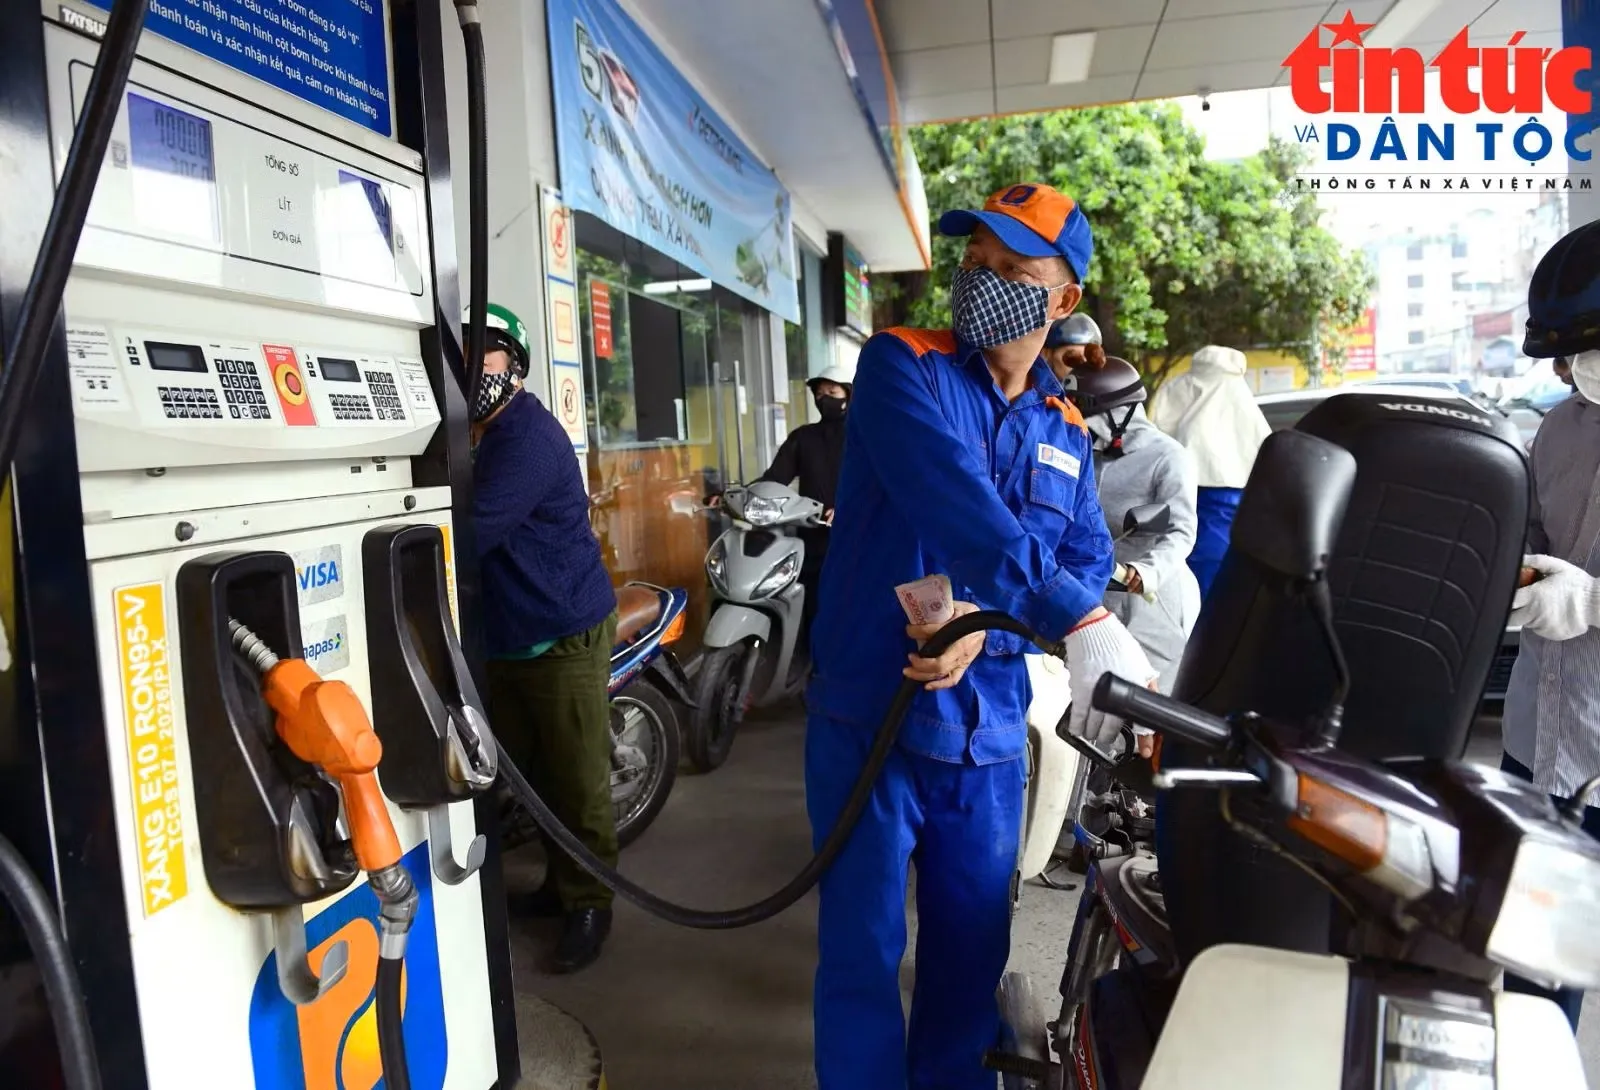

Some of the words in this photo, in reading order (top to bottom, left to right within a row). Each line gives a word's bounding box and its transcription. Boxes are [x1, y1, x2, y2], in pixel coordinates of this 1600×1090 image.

[150, 0, 182, 25] thanh
[184, 16, 208, 37] toán
[210, 29, 223, 44] và
[226, 37, 243, 53] xác
[244, 46, 268, 66] nhận
[270, 54, 284, 73] kết
[324, 84, 334, 97] ơn
[336, 87, 358, 108] khách
[230, 14, 250, 33] màn
[253, 22, 274, 44] hình
[276, 37, 290, 54] cột
[290, 42, 310, 63] bơm
[312, 54, 334, 75] trước
[335, 65, 348, 82] khi
[348, 74, 369, 93] thanh
[264, 8, 280, 24] của
[281, 14, 307, 38] khách
[264, 154, 286, 172] TỔNG
[288, 164, 300, 177] SỐ
[278, 196, 292, 212] LÍT
[272, 230, 288, 242] ĐƠN
[289, 234, 302, 246] GIÁ
[1378, 402, 1492, 428] HONDA
[298, 560, 339, 590] VISA
[122, 592, 157, 738] RON95-V
[151, 636, 173, 742] 2026/PLX
[136, 743, 163, 805] E10
[164, 787, 184, 851] TCCS
[143, 808, 173, 908] XĂNG
